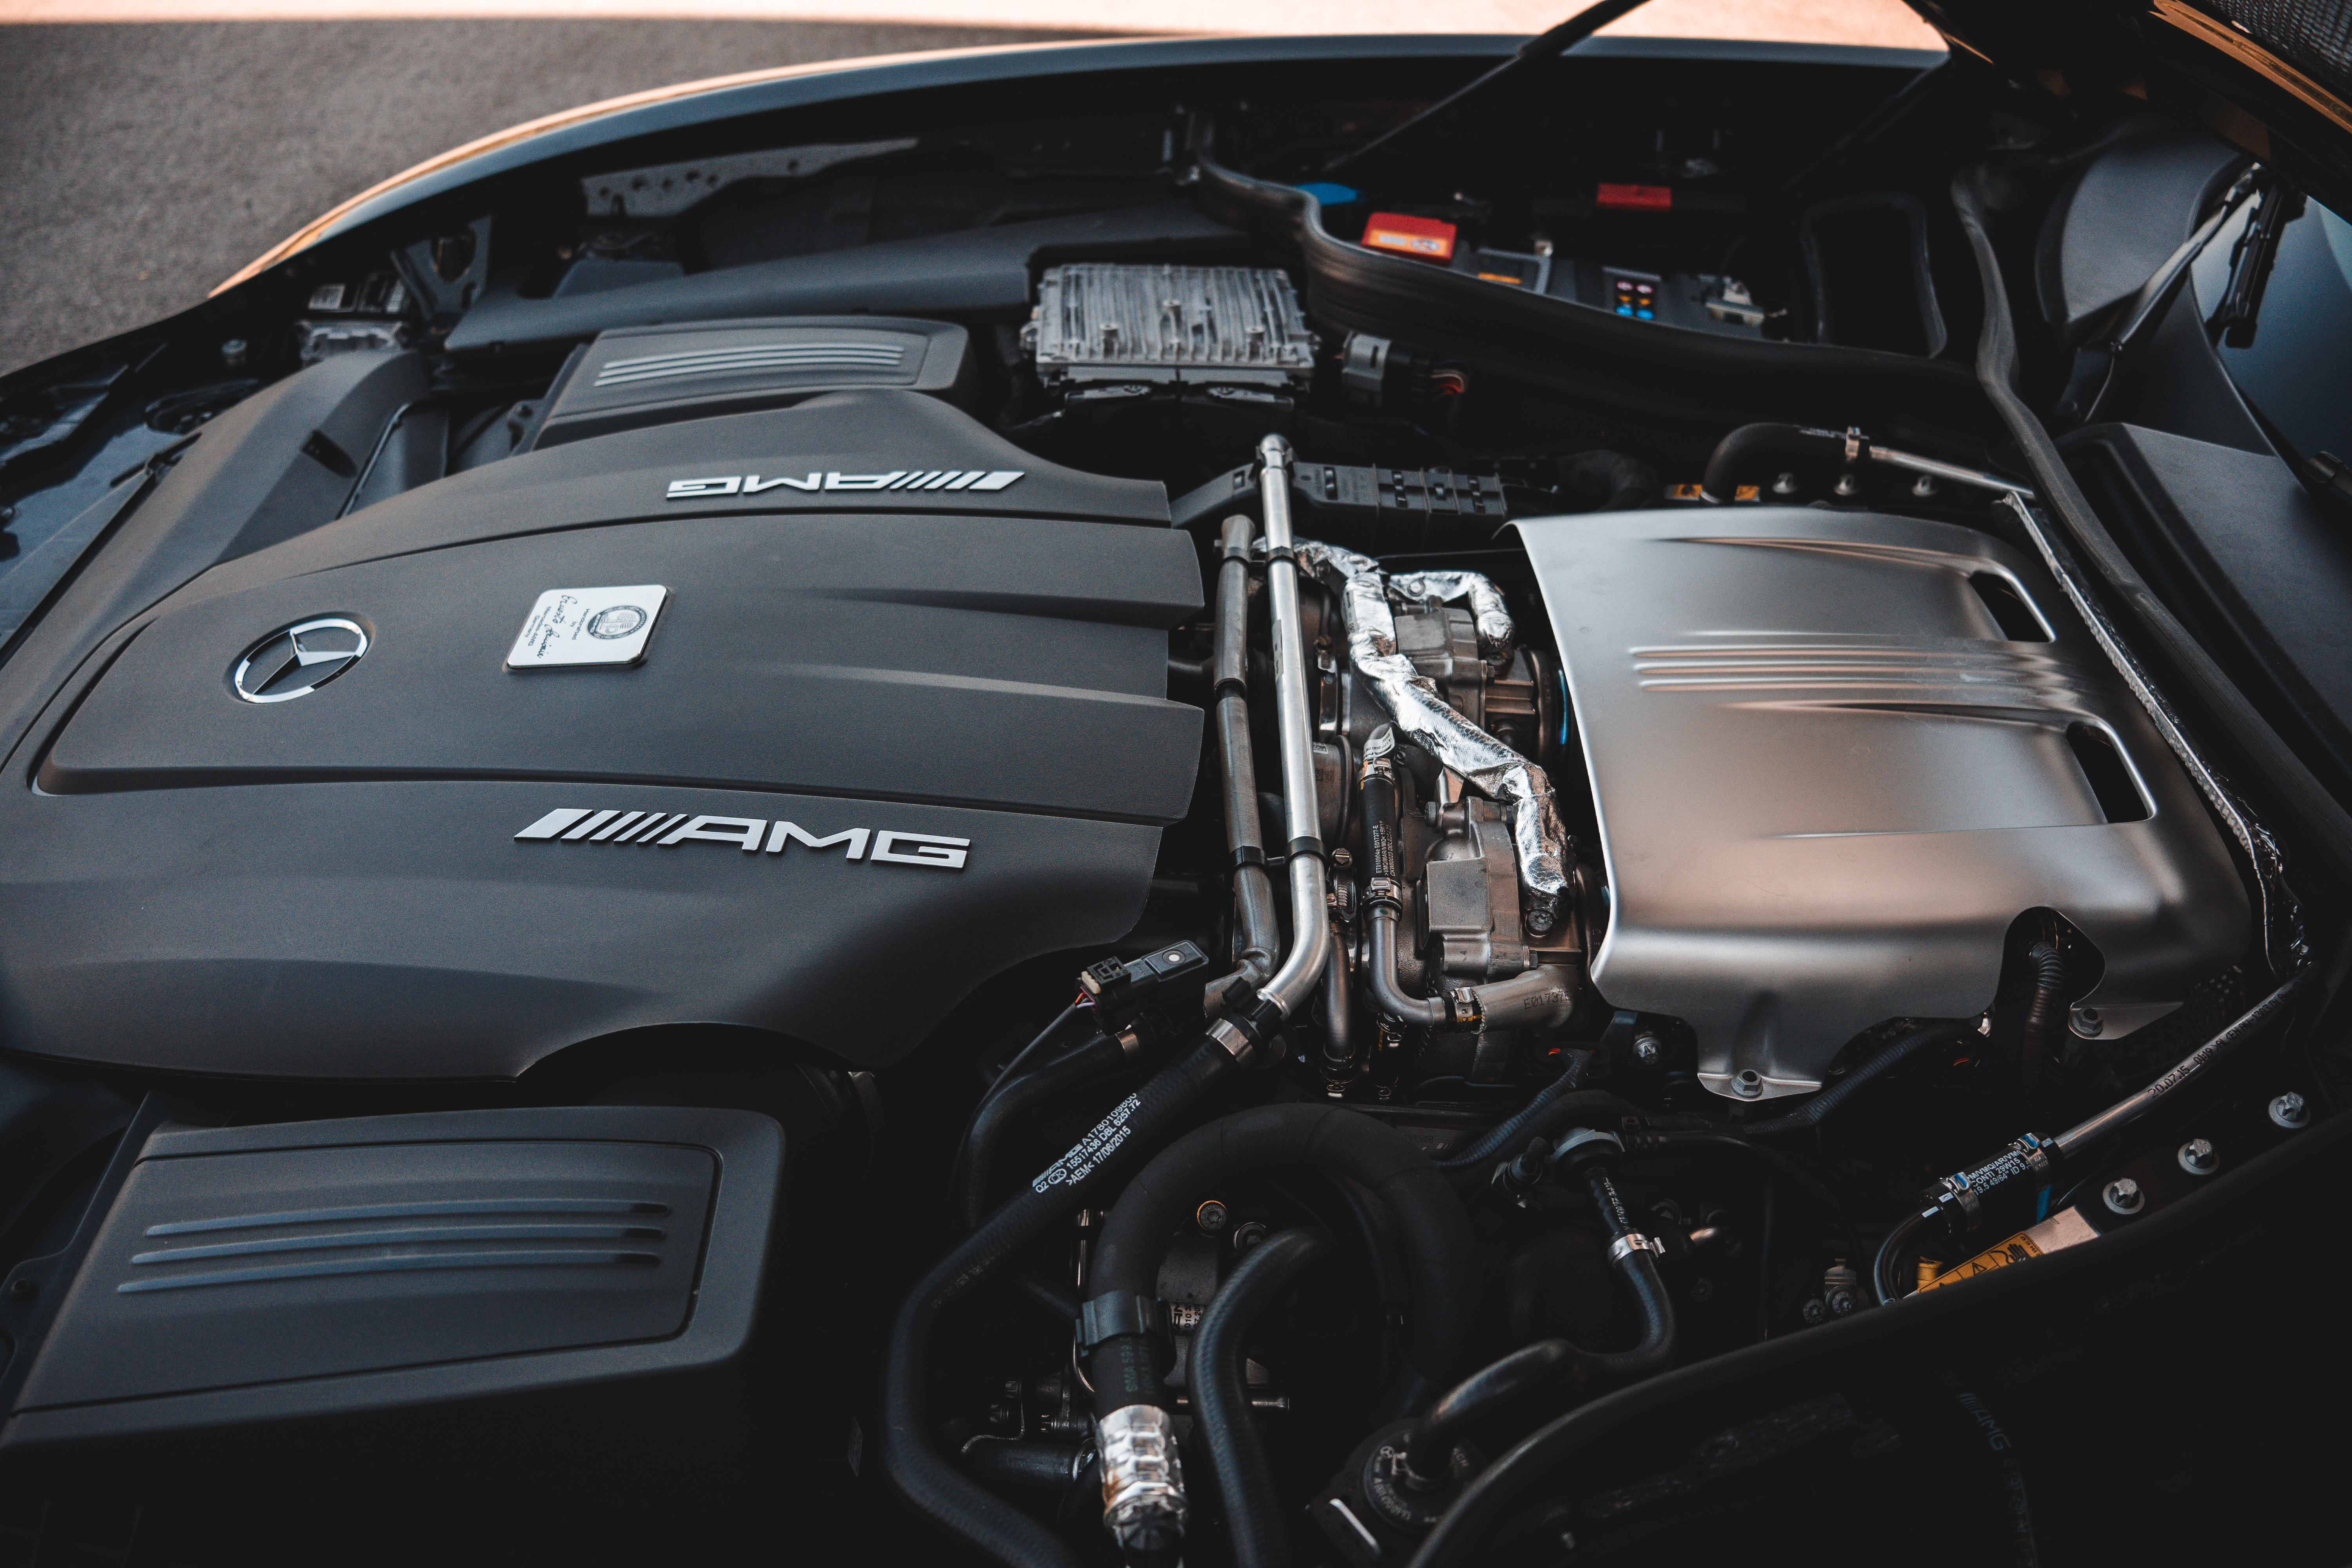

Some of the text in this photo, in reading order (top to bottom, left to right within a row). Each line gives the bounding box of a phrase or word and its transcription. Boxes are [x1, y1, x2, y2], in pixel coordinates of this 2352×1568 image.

[666, 472, 908, 499] AMG
[524, 615, 540, 638] Germany
[528, 606, 551, 646] Mercedes-AMG
[572, 608, 590, 640] Handcrafted
[657, 815, 971, 868] AMG
[2147, 1065, 2190, 1098] 20.07.15
[1035, 1181, 1049, 1193] Q2
[1066, 1138, 1101, 1170] 15517436
[1099, 1126, 1117, 1142] DBL
[1113, 1099, 1141, 1127] 6257.72
[1065, 1125, 1131, 1186] >AEM< 17/06/2015
[1972, 1171, 1995, 1188] CONTI
[1997, 1158, 2021, 1176] 29W15
[2011, 1167, 2020, 1176] ID
